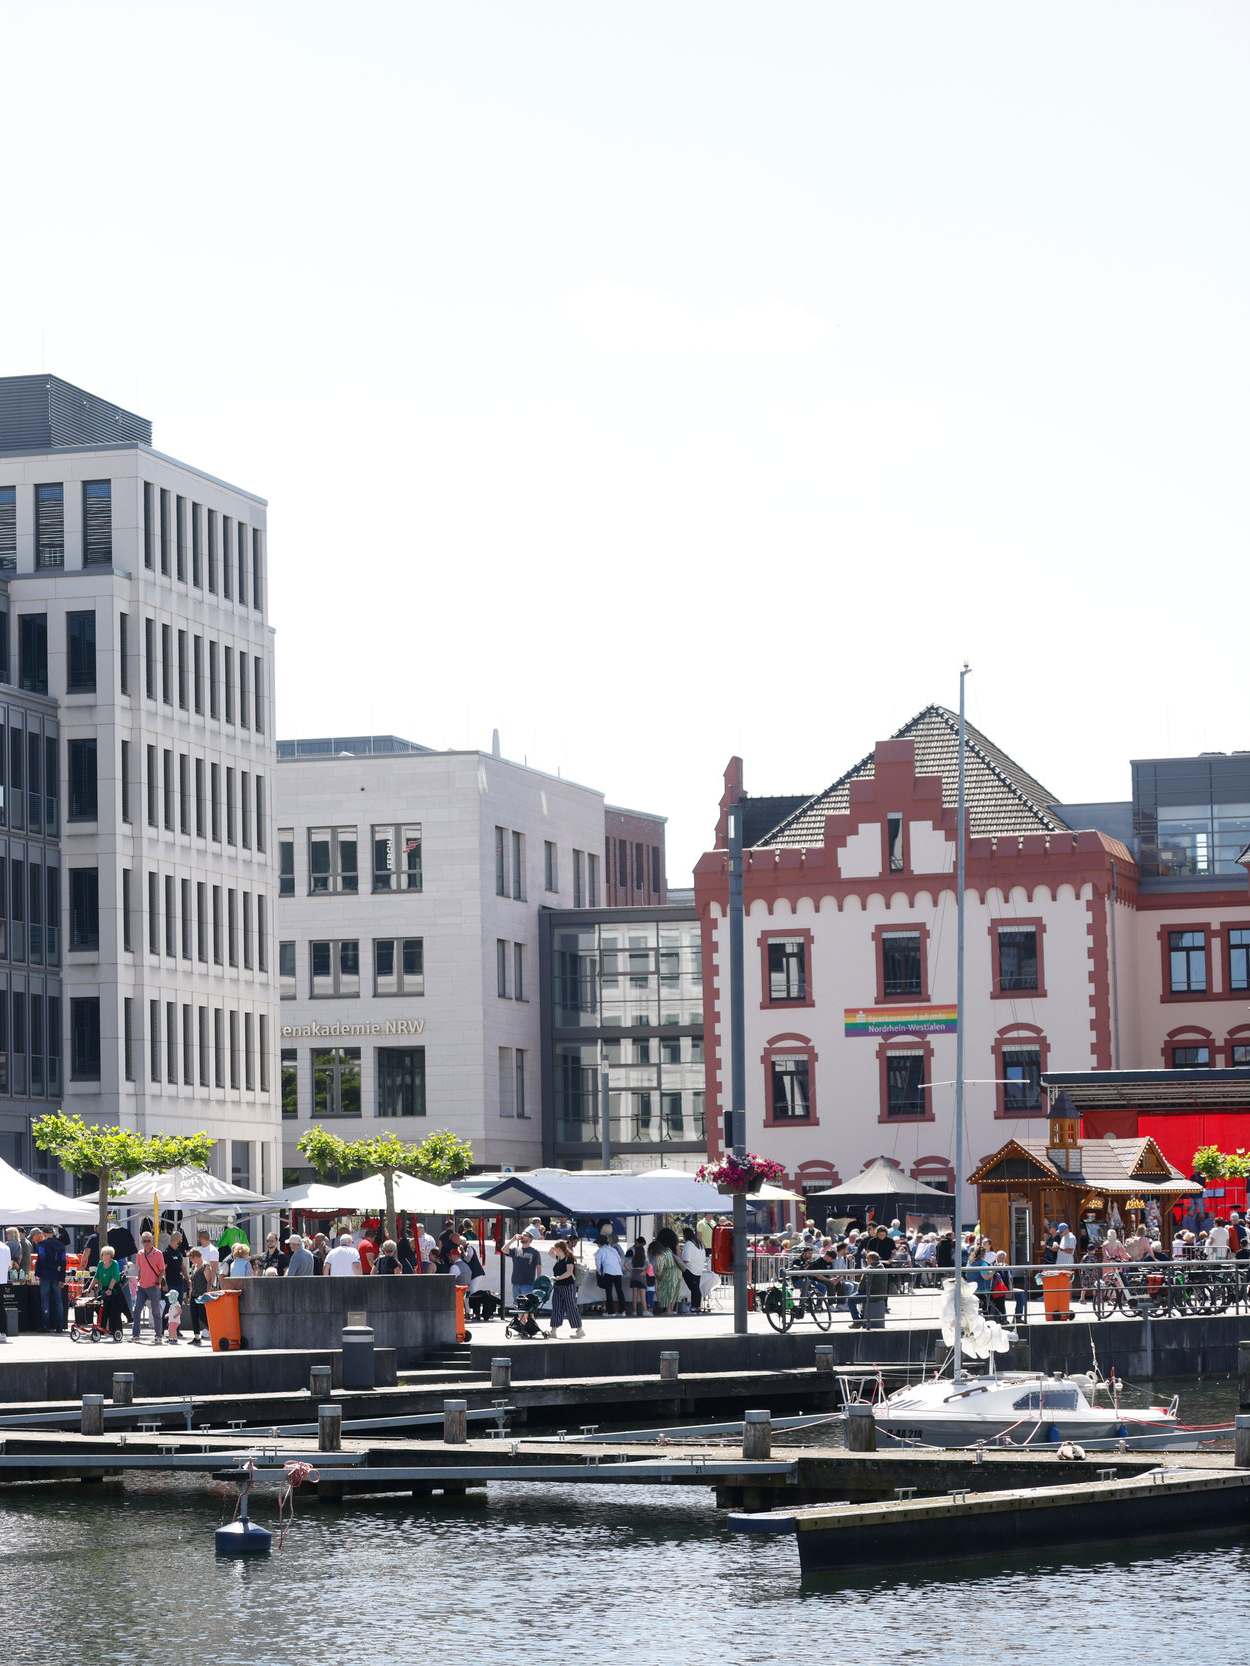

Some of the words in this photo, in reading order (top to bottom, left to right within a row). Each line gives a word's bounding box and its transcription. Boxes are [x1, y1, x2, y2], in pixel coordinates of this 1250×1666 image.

[281, 1020, 380, 1037] enakademie
[386, 1019, 425, 1034] NRW
[868, 1023, 946, 1033] Nordrhein-Westfalen
[179, 1165, 198, 1179] ALL
[180, 1176, 199, 1188] FOR
[695, 1466, 702, 1474] 21
